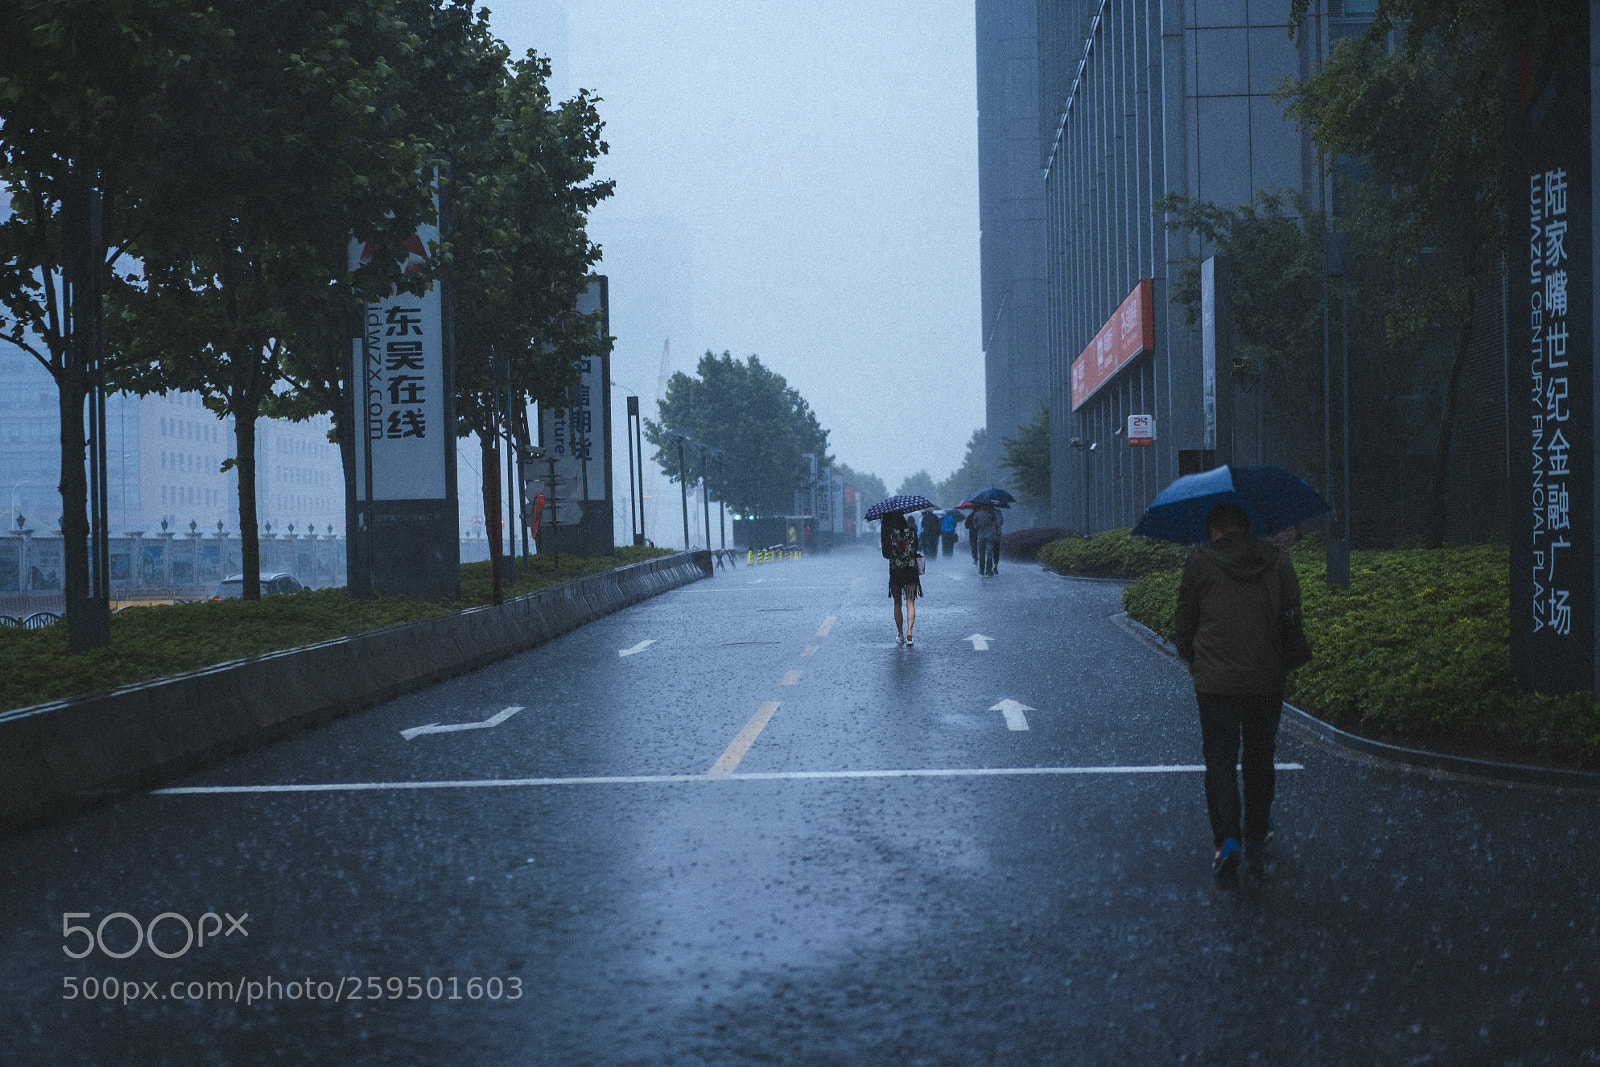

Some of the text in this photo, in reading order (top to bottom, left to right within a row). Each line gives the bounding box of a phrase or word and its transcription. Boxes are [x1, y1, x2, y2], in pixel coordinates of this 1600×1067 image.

[385, 306, 426, 439] 东吴在线
[1530, 174, 1544, 632] LUJIAZUI CENTURY FINANCIAL PLAZA
[1544, 167, 1571, 635] 陆家嘴世纪金融广场
